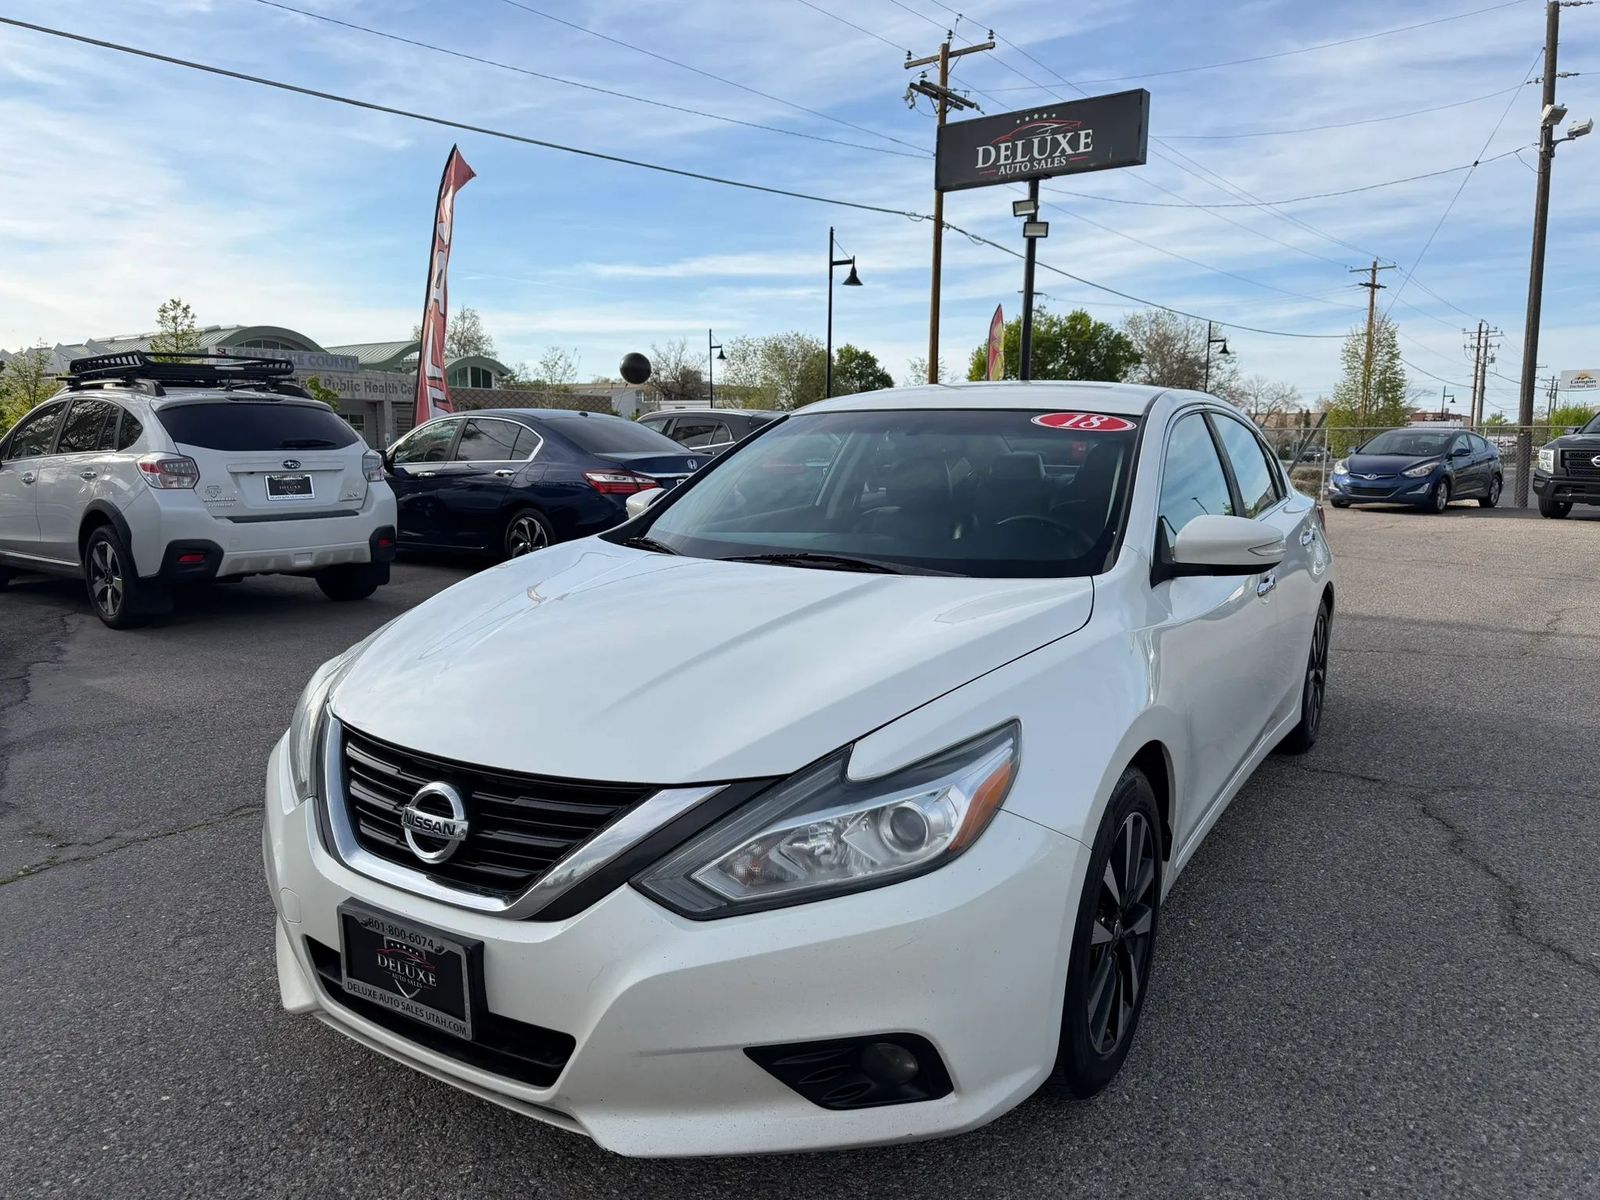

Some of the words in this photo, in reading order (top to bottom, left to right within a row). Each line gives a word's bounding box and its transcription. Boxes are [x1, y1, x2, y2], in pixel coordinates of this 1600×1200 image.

[975, 129, 1093, 169] DELUXE
[998, 161, 1030, 176] AUTO
[1032, 156, 1067, 171] SALES
[308, 354, 357, 369] COUNTY
[323, 378, 361, 393] Public
[364, 380, 398, 395] Health
[1058, 414, 1109, 429] 18
[403, 810, 456, 836] NISSAN
[368, 918, 434, 949] 801-800-6074
[377, 954, 437, 986] DELUXE
[406, 977, 423, 988] SALES
[347, 981, 377, 999] DELUXE
[378, 993, 400, 1008] AUTO
[401, 1001, 425, 1019] SALES
[425, 1012, 466, 1035] UTAH.COM
